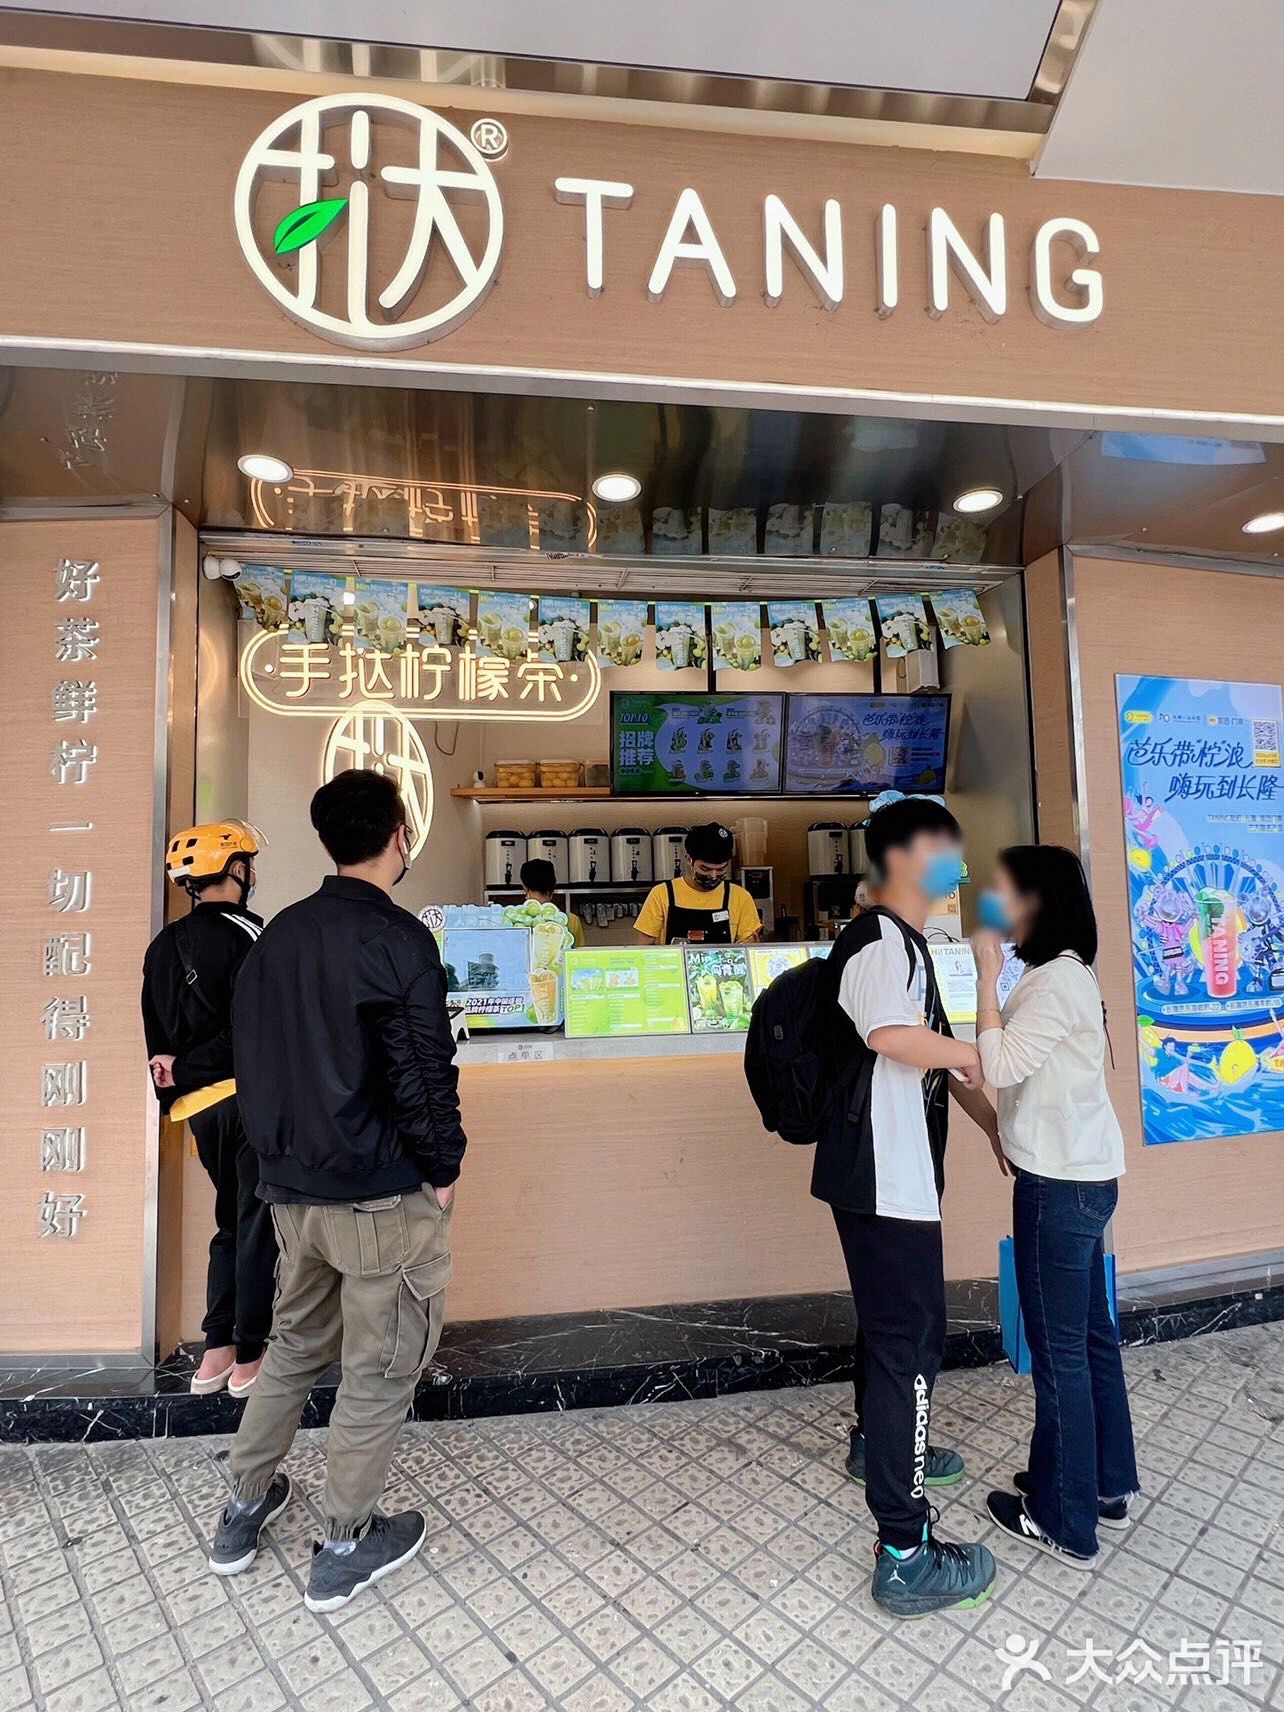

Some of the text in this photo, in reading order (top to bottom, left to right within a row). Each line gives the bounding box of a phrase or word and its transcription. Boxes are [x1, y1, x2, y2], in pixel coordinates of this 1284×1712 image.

[554, 176, 1104, 325] TANING
[619, 730, 654, 748] 招牌
[619, 748, 654, 766] 推荐
[40, 558, 101, 1240] 好茶鲜柠一切配得刚刚好
